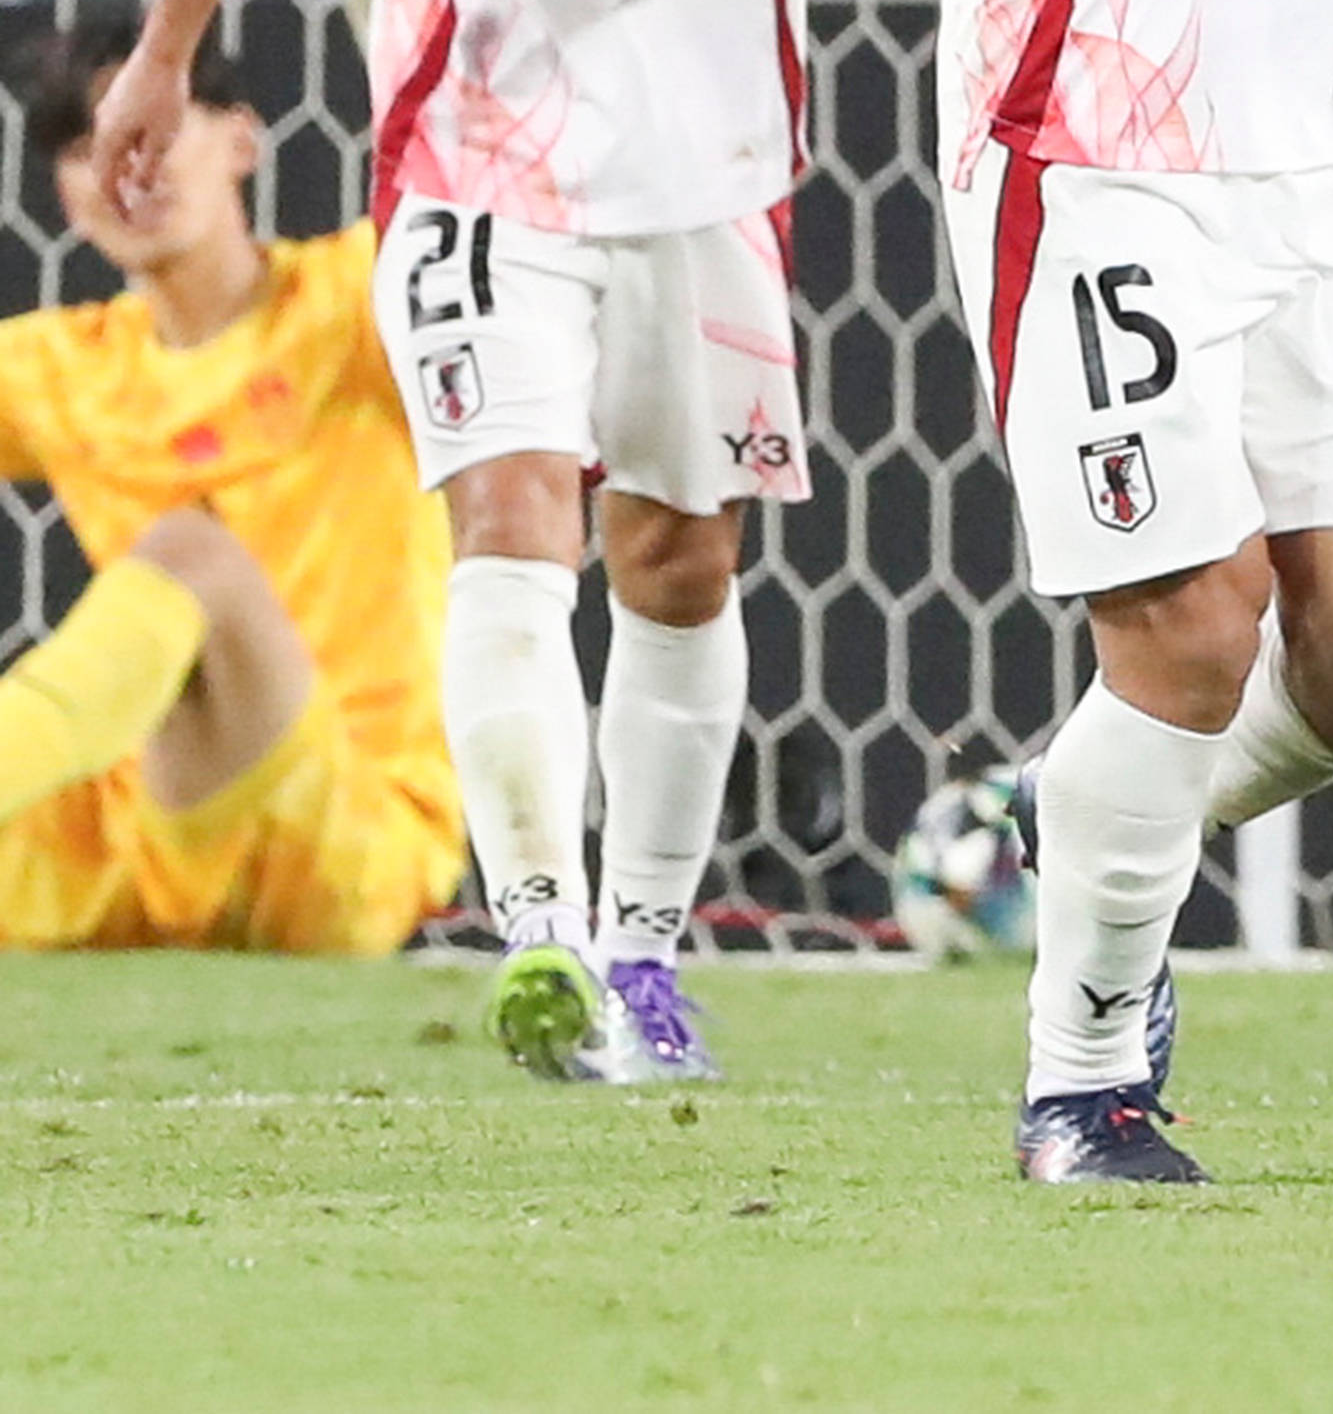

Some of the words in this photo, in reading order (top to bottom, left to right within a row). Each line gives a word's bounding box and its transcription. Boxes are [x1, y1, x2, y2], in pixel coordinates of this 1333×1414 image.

[406, 208, 495, 332] 21
[1072, 263, 1178, 412] 15
[722, 432, 791, 469] Y-3
[612, 889, 684, 935] Y-3
